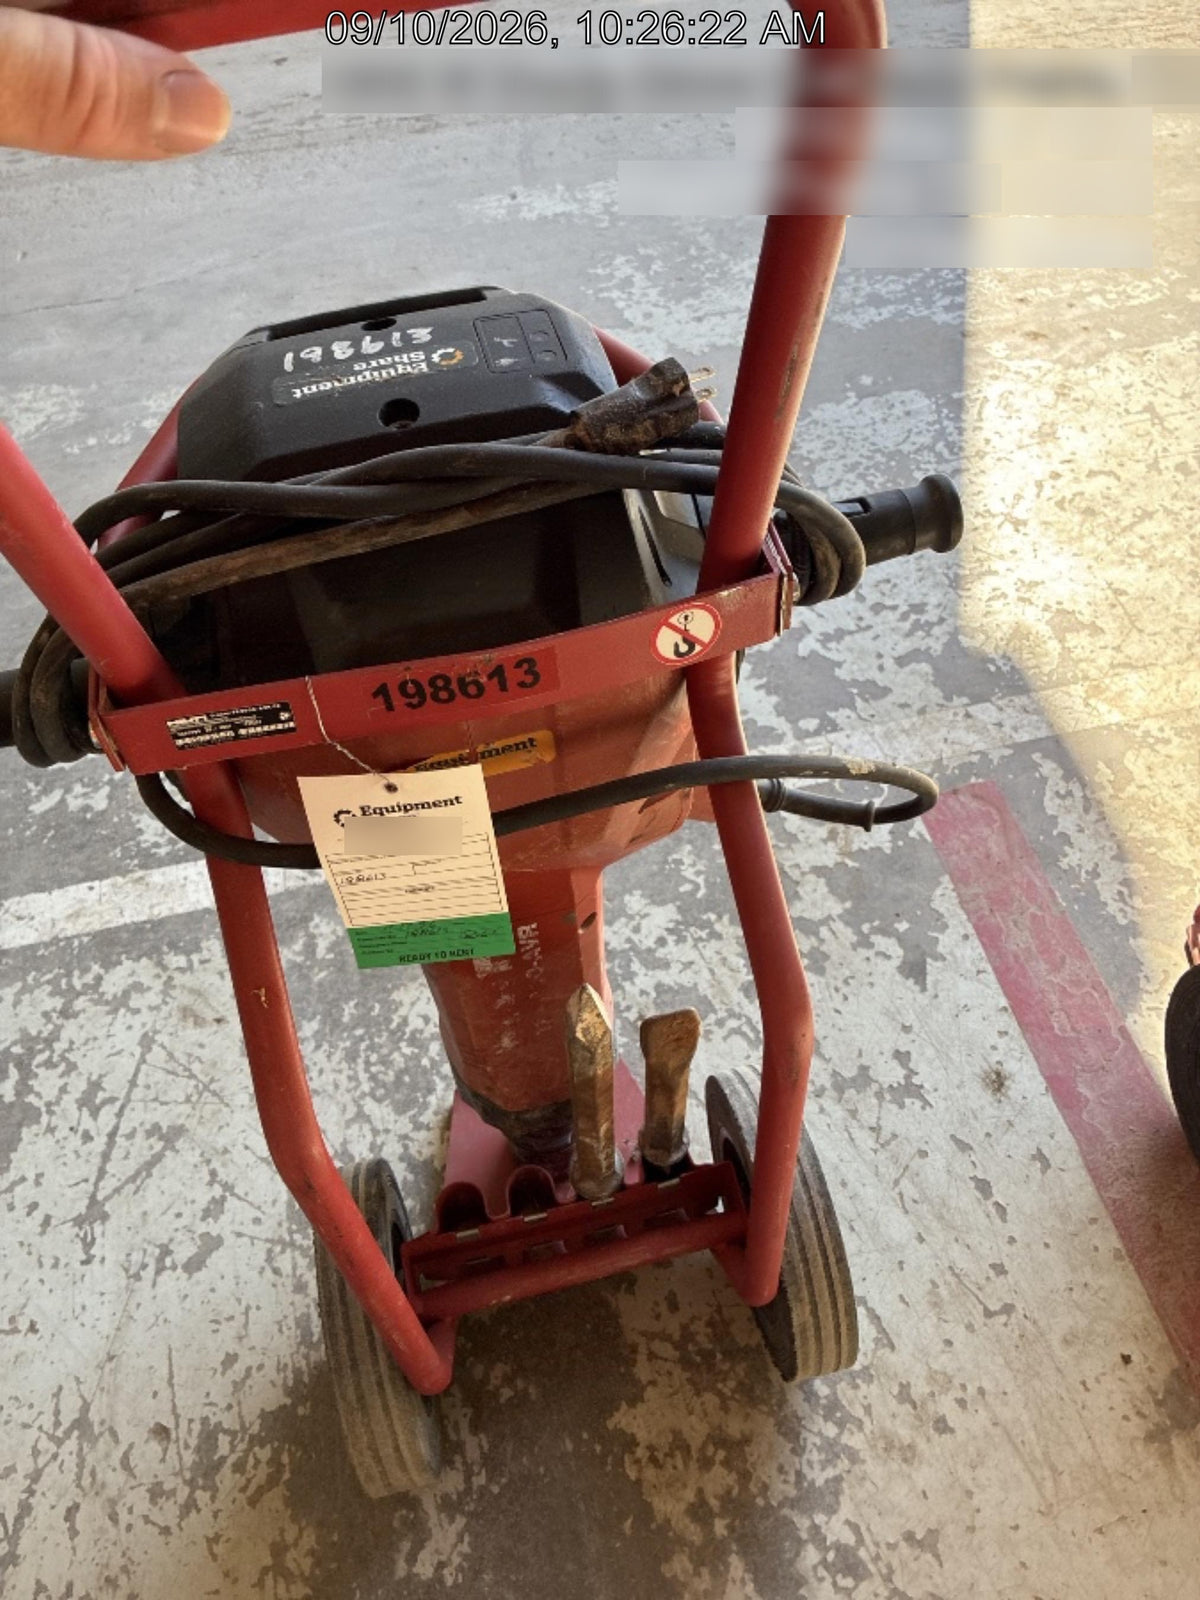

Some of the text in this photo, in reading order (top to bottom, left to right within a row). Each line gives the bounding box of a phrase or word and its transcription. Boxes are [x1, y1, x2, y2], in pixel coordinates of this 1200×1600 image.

[352, 351, 426, 371] Share
[291, 362, 428, 398] Equipment
[372, 657, 541, 711] 198613
[359, 795, 462, 816] Equipment
